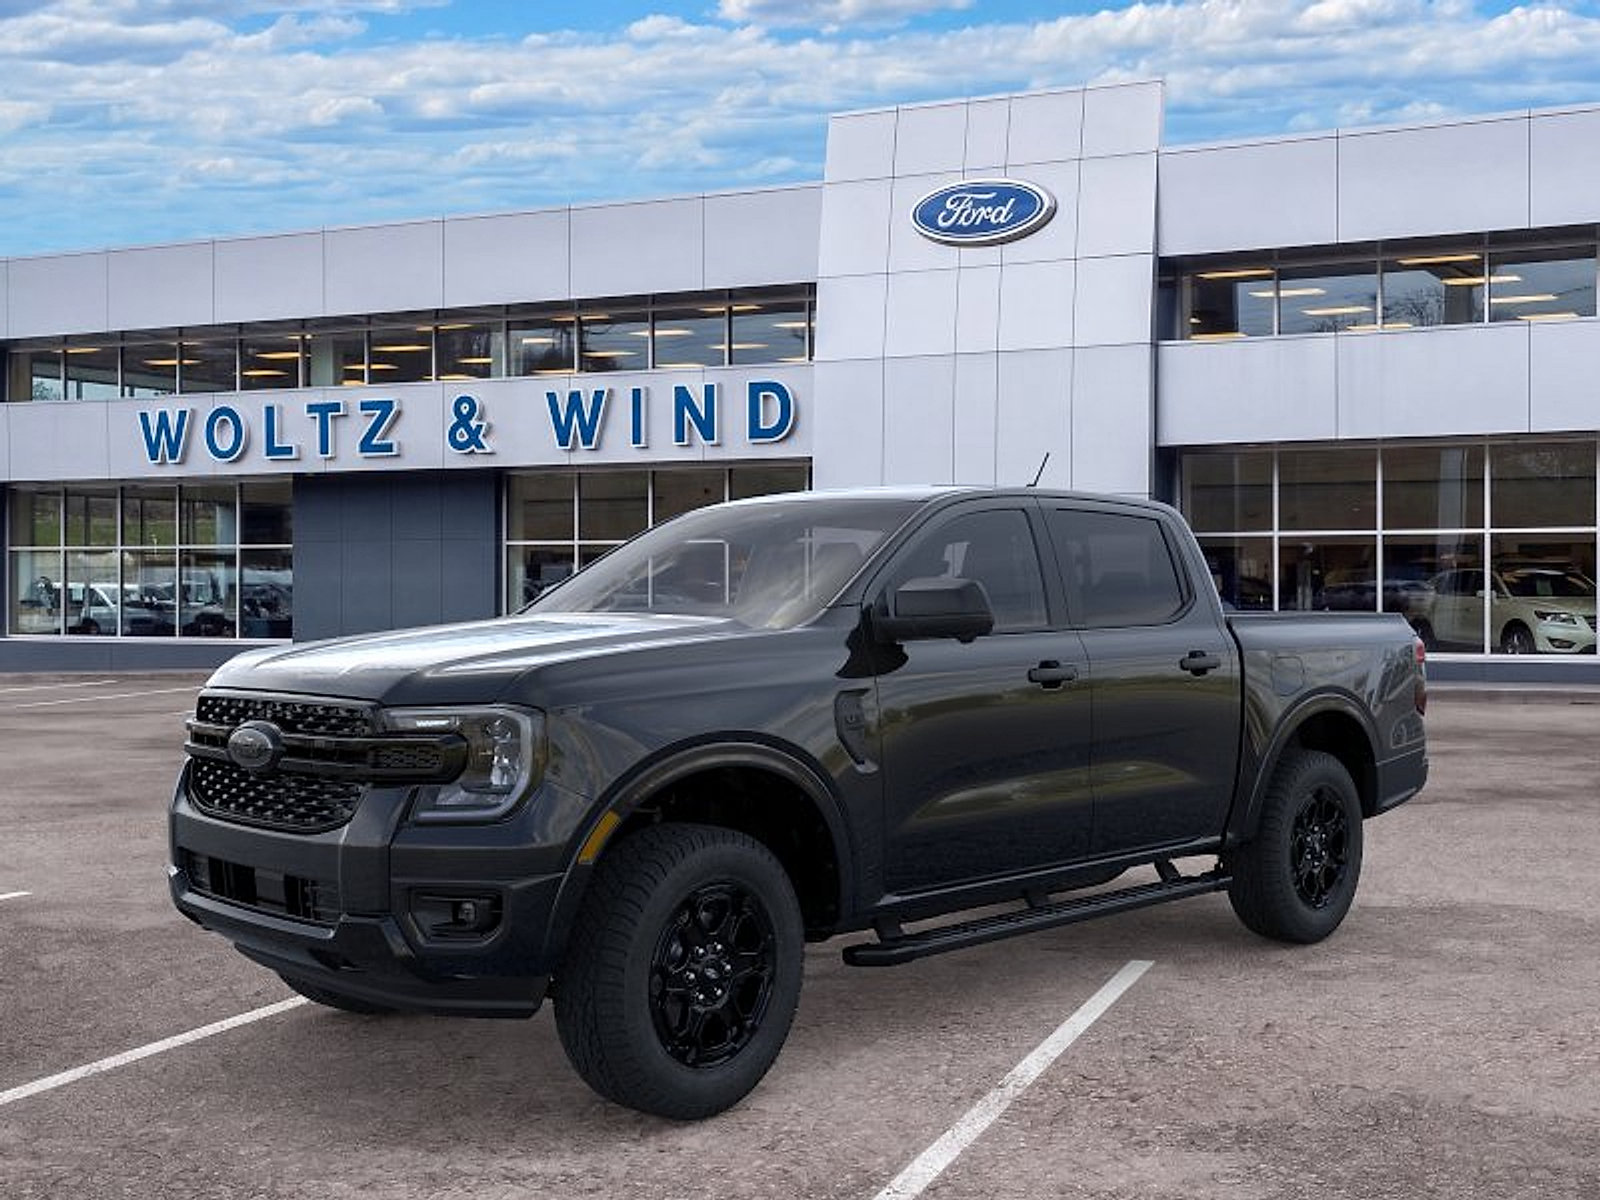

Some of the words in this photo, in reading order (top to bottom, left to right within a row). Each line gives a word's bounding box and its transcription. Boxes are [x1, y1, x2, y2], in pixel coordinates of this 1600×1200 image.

[938, 192, 1015, 228] Ford
[138, 398, 400, 464] WOLTZ
[448, 395, 493, 455] &
[545, 380, 796, 450] WIND
